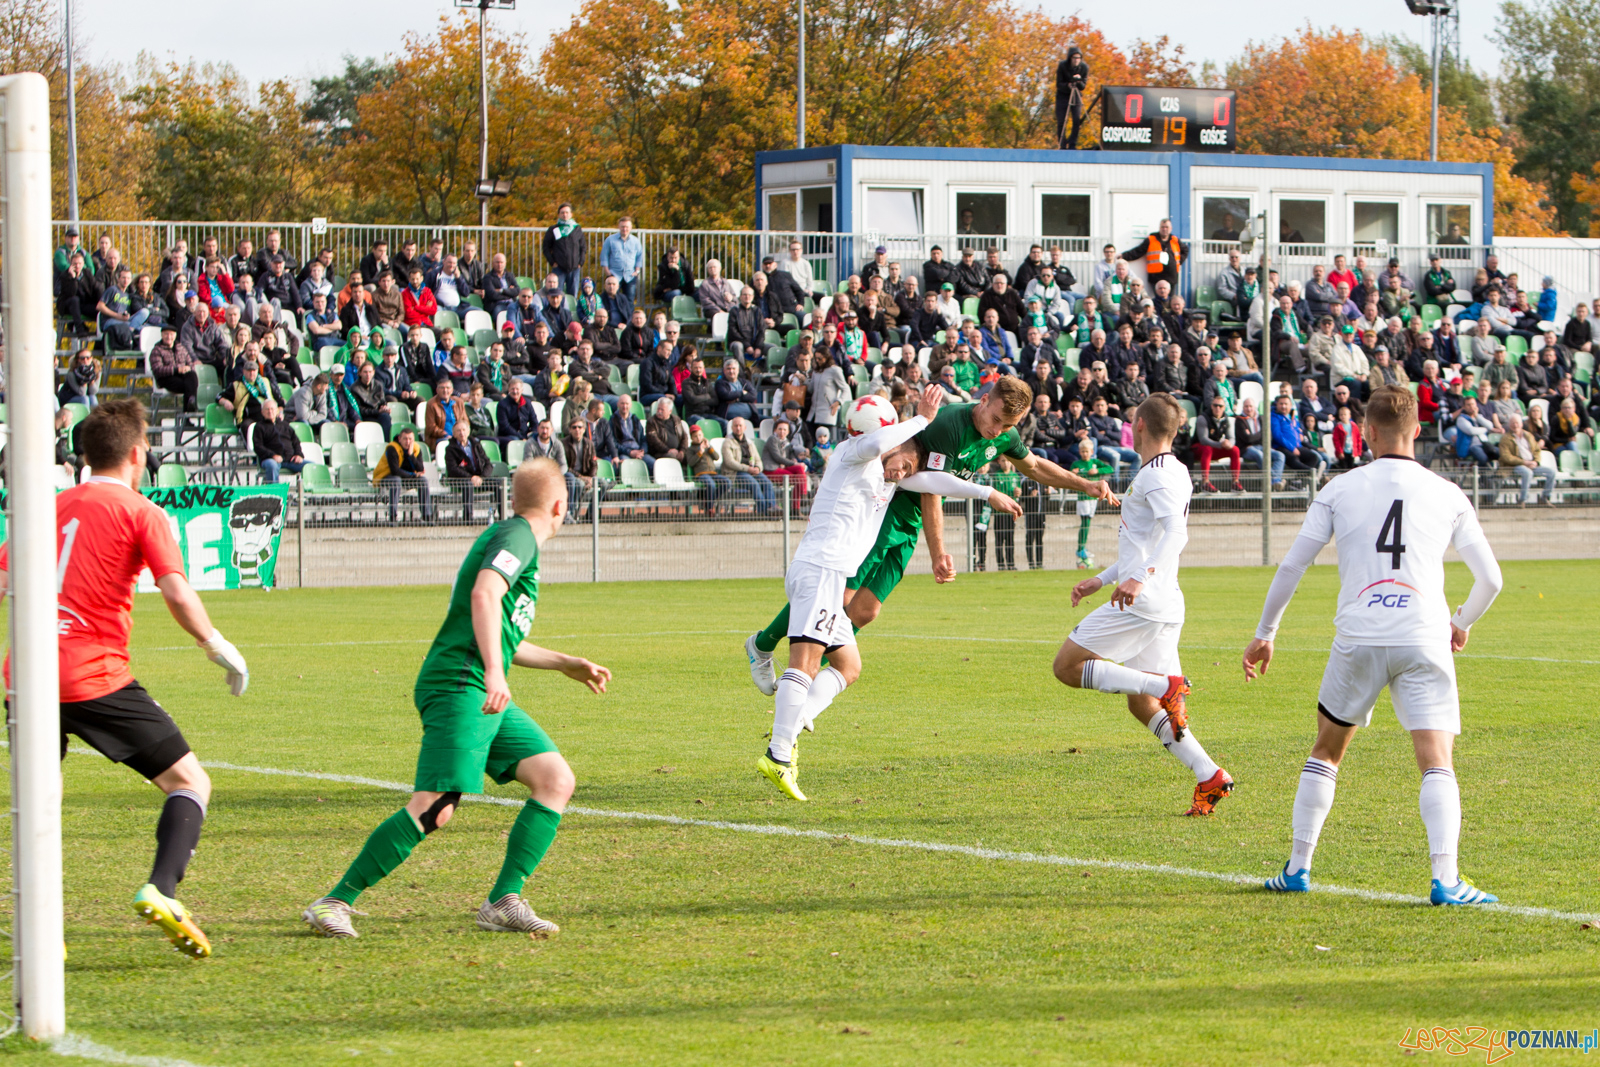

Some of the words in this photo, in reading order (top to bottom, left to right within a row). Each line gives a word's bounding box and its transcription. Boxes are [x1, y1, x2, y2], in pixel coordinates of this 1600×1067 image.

[1124, 94, 1143, 123] 0
[1160, 97, 1180, 112] CZAS
[1213, 97, 1231, 126] 0
[1102, 126, 1152, 143] GOSPODARZE
[1162, 116, 1187, 145] 19
[1200, 126, 1227, 145] GOŚCIE
[1375, 499, 1406, 570] 4
[1367, 594, 1411, 608] PGE
[815, 608, 836, 636] 24
